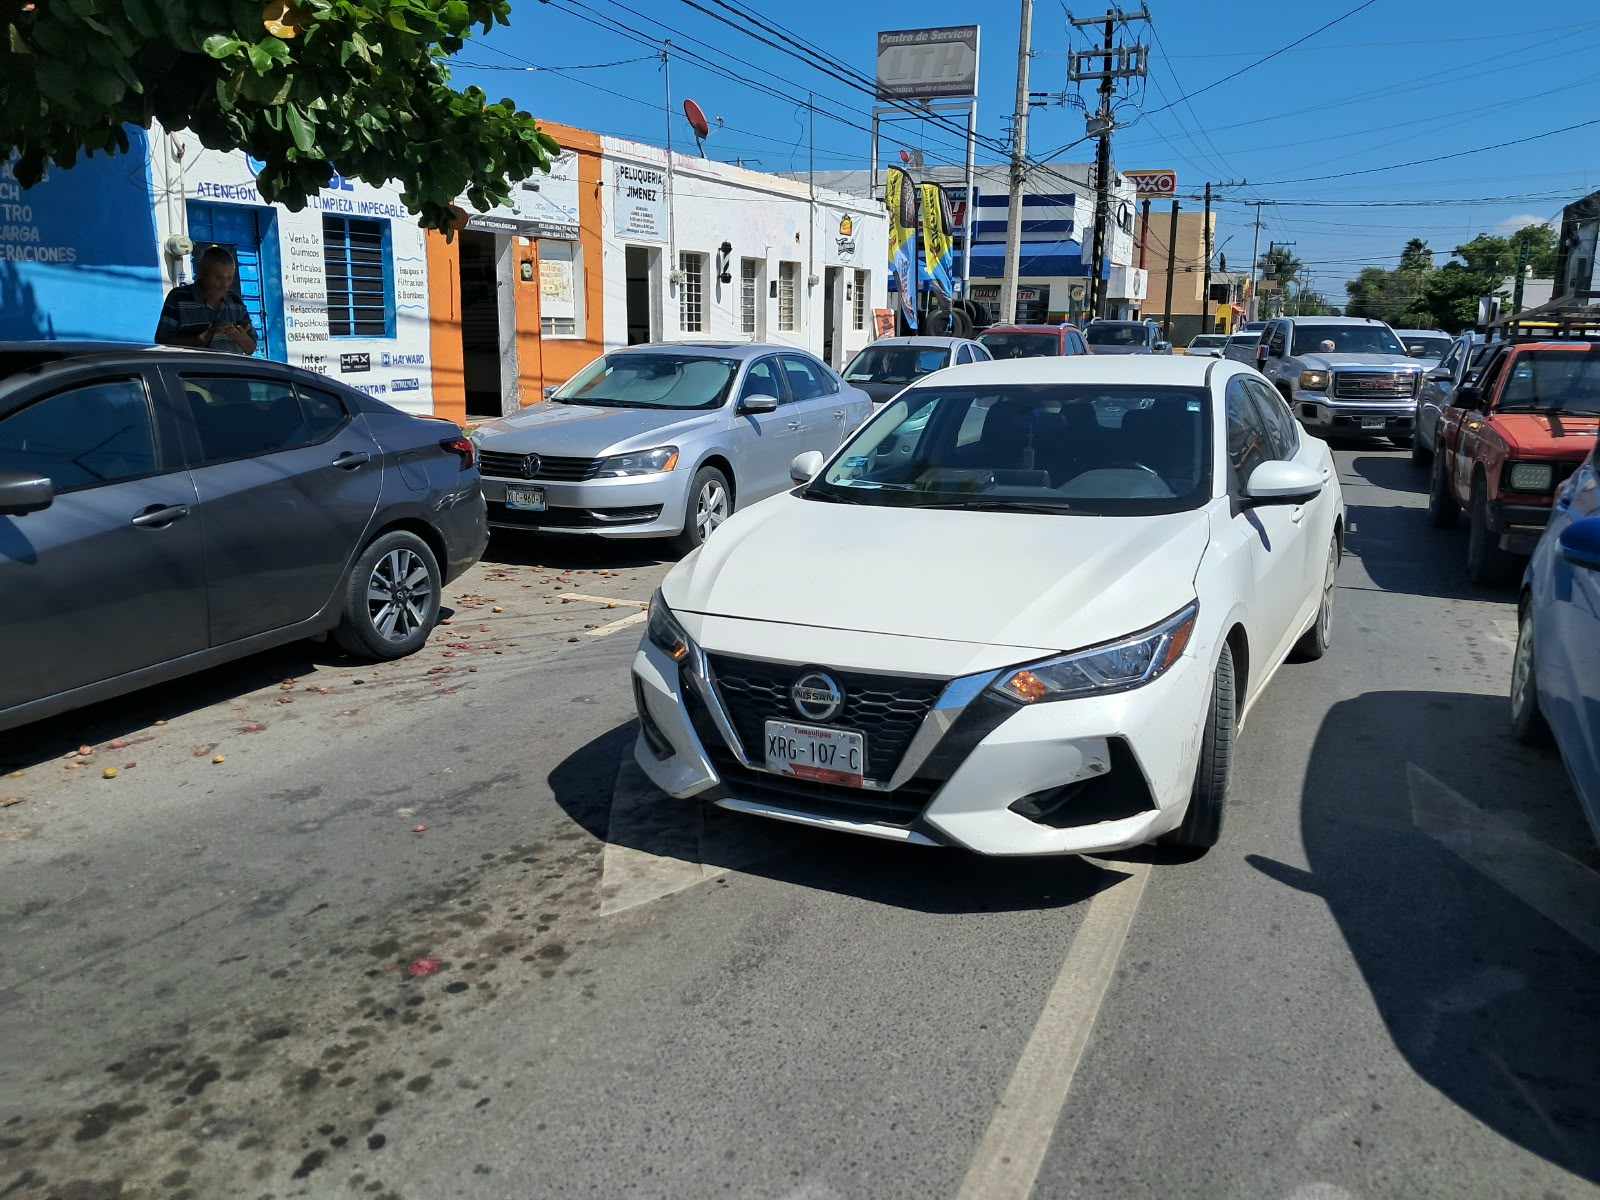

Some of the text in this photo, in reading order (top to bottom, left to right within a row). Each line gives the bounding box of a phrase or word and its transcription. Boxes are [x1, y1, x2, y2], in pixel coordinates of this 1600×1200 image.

[880, 29, 973, 43] Centro de Servicio
[626, 185, 657, 202] JIMENEZ
[313, 197, 353, 213] LIMPIEZA
[0, 226, 40, 242] ARGA
[288, 231, 310, 245] Venta
[392, 354, 425, 365] HAYWARD
[793, 688, 837, 701] NISSAN
[768, 735, 858, 770] XRG-107-C
